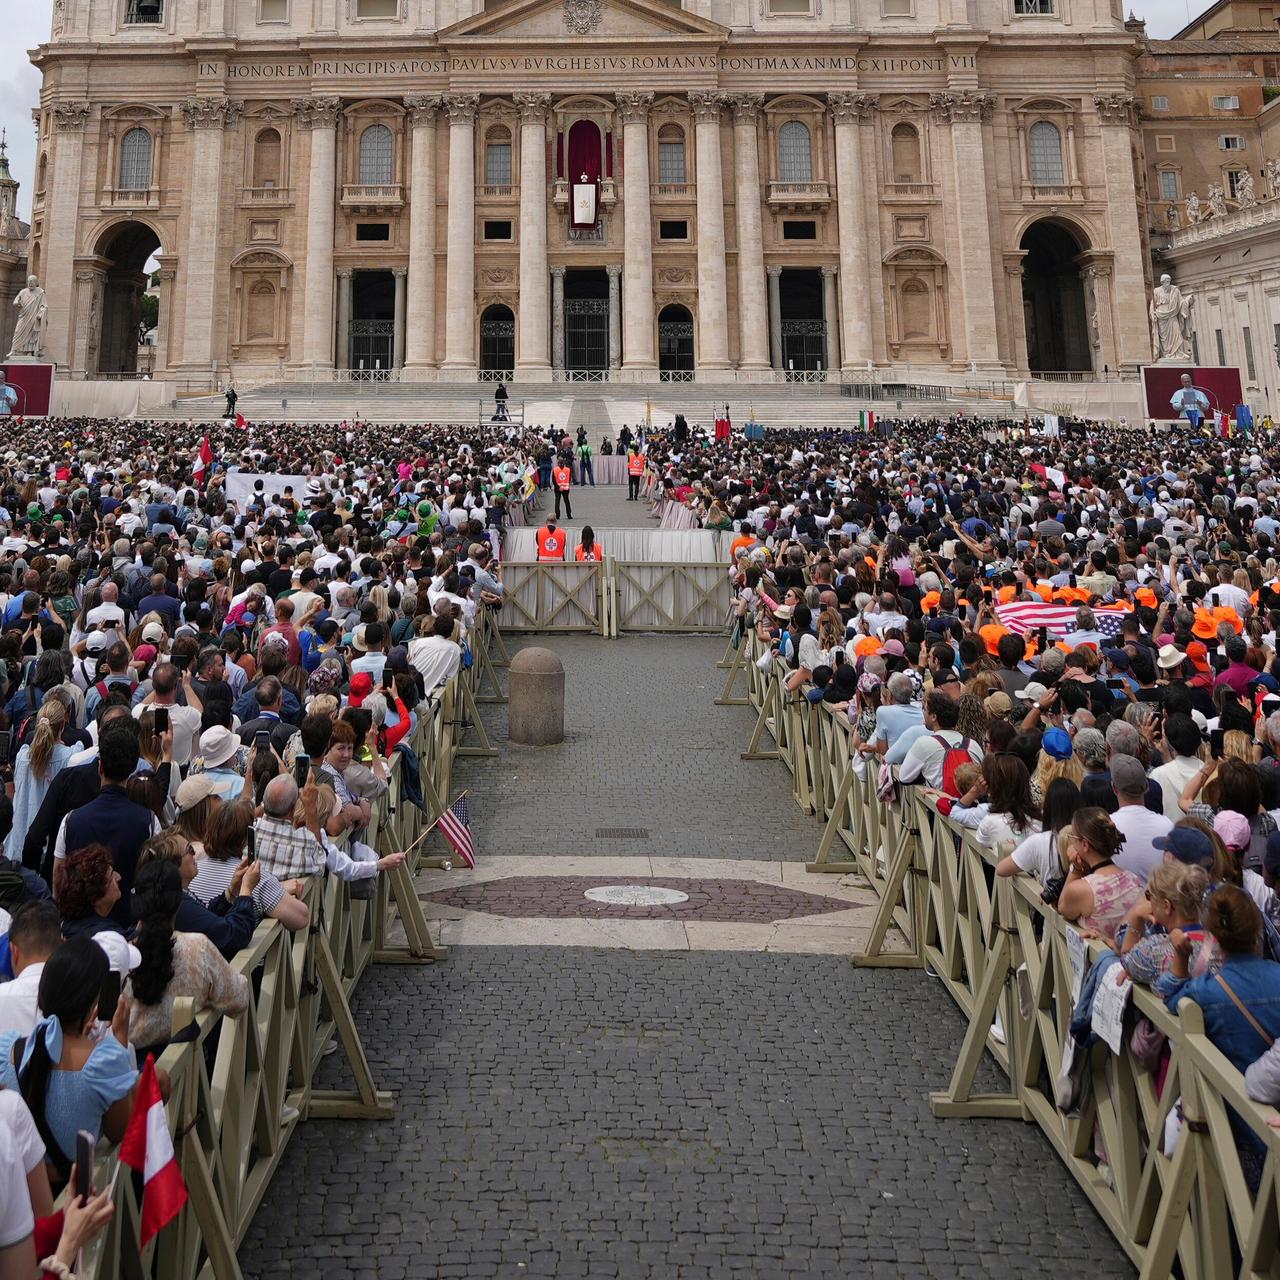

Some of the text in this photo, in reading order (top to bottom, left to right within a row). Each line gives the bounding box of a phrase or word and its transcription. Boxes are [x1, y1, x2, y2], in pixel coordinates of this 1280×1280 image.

[199, 63, 218, 75] IN
[227, 64, 310, 78] HONOREM
[313, 61, 397, 75] PRINCIPIS
[399, 60, 450, 73] APOST
[451, 57, 509, 71] PAVLVS
[523, 57, 627, 71] BVRGHESIVS
[631, 56, 717, 70] ROMANVS
[720, 57, 763, 71] PONT
[763, 57, 803, 70] MAX
[803, 57, 826, 70] AN
[828, 57, 895, 71] MDCXII
[898, 58, 944, 71] PONT
[950, 56, 976, 68] VII
